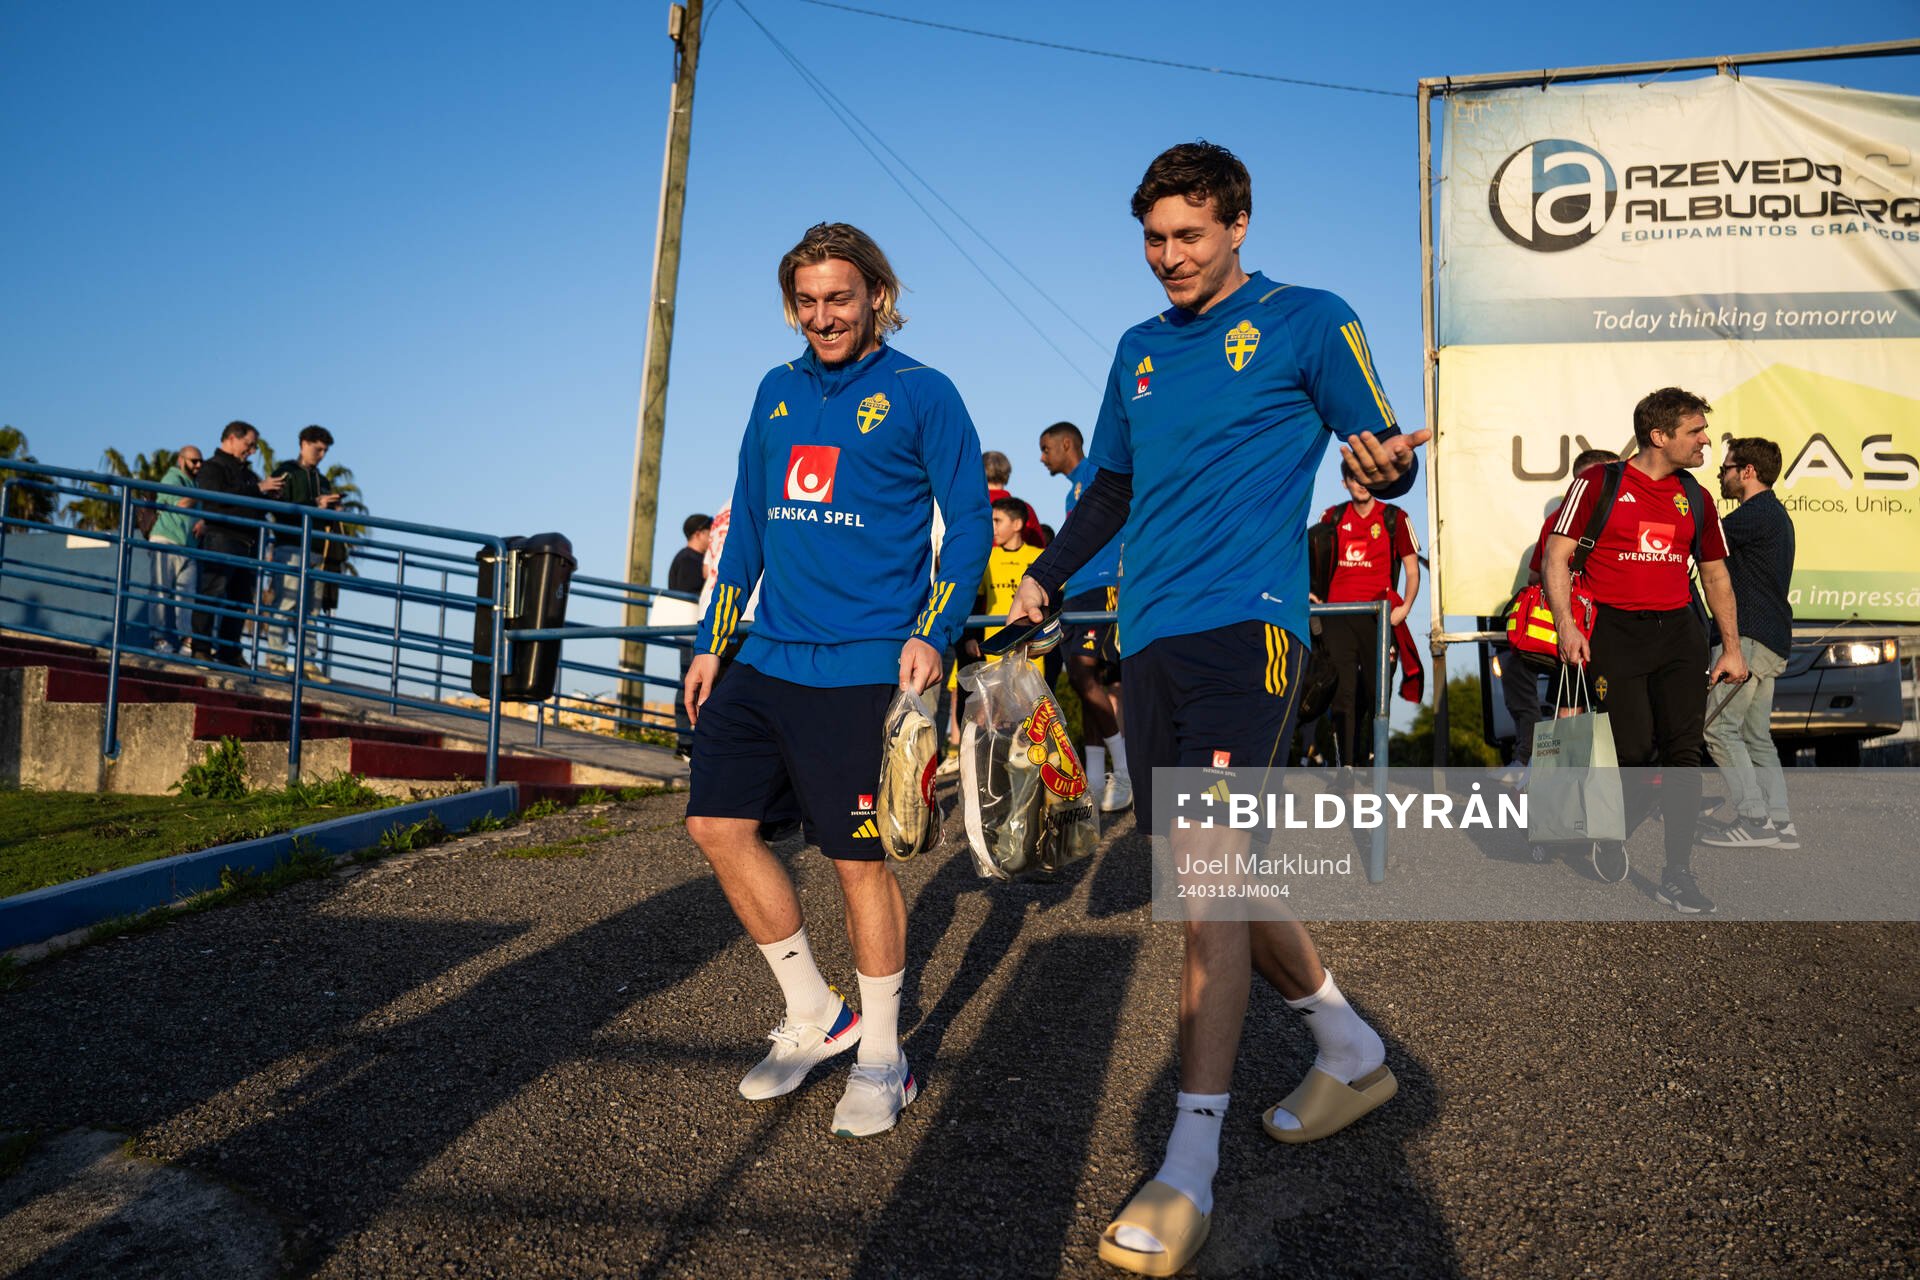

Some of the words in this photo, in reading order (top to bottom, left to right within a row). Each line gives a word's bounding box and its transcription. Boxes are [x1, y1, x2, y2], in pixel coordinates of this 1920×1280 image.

[1625, 157, 1842, 190] AZEVEDO
[1621, 225, 1798, 242] EQUIPAMENTOS
[1592, 310, 1662, 333] Today
[1668, 306, 1768, 332] thinking
[1775, 308, 1897, 326] tomorrow
[823, 510, 865, 528] SPEL
[1617, 552, 1667, 562] SVENSKA
